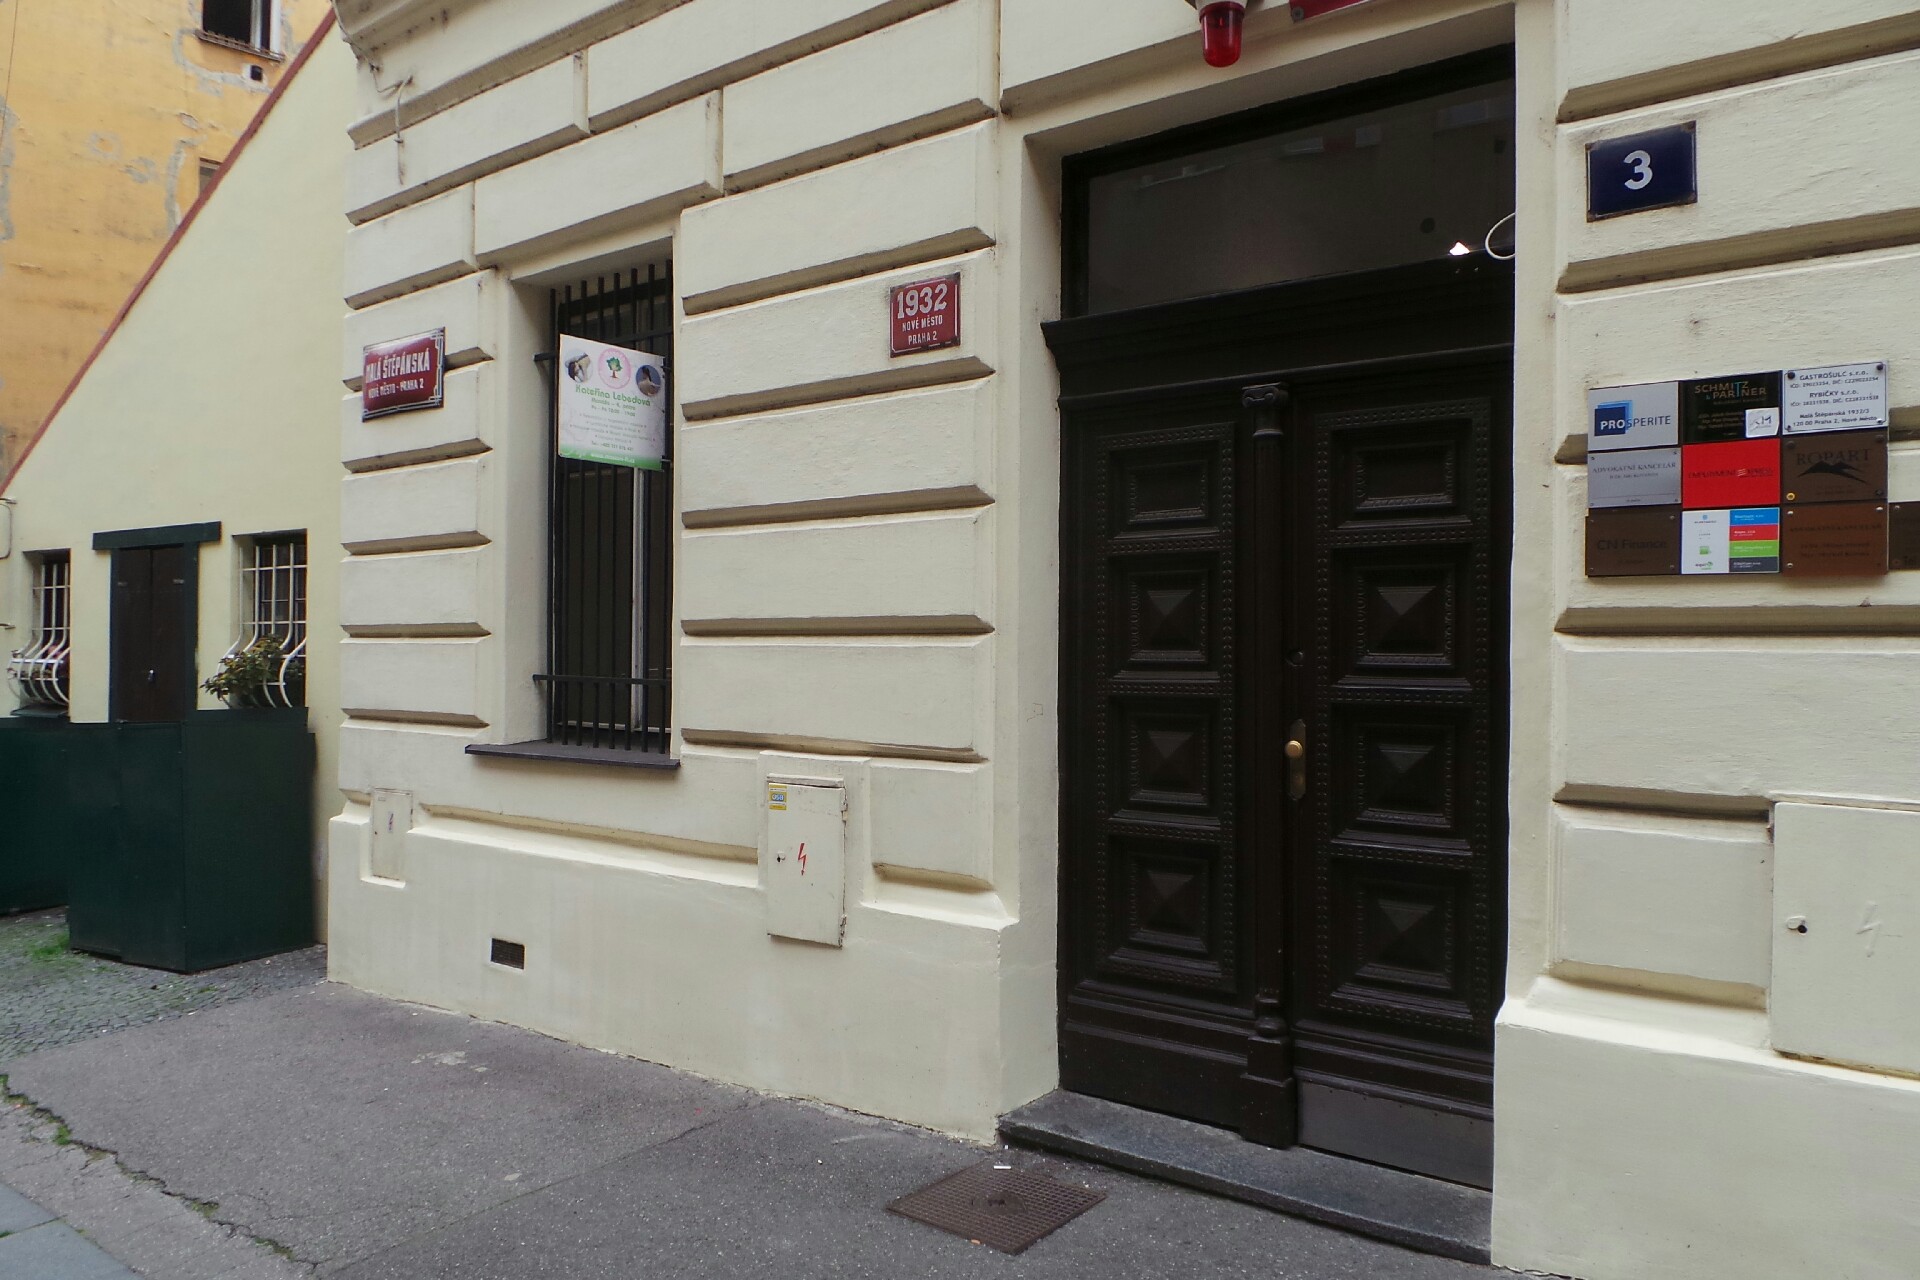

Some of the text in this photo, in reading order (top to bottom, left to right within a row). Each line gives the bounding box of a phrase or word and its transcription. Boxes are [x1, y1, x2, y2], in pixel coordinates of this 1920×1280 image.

[1623, 149, 1653, 190] 3
[896, 283, 948, 319] 1932
[902, 314, 943, 332] NOVÉ MĚSTO
[908, 330, 938, 345] PRAHA 2
[382, 348, 430, 379] ŠTĚPÁNSKÁ
[420, 378, 424, 389] 2
[1694, 381, 1749, 394] SCHMITZ
[575, 384, 651, 407] Kateřina Lebedová
[1712, 387, 1767, 399] PARTNER
[1600, 415, 1671, 430] PROSPERITE
[1796, 448, 1873, 465] ROPART
